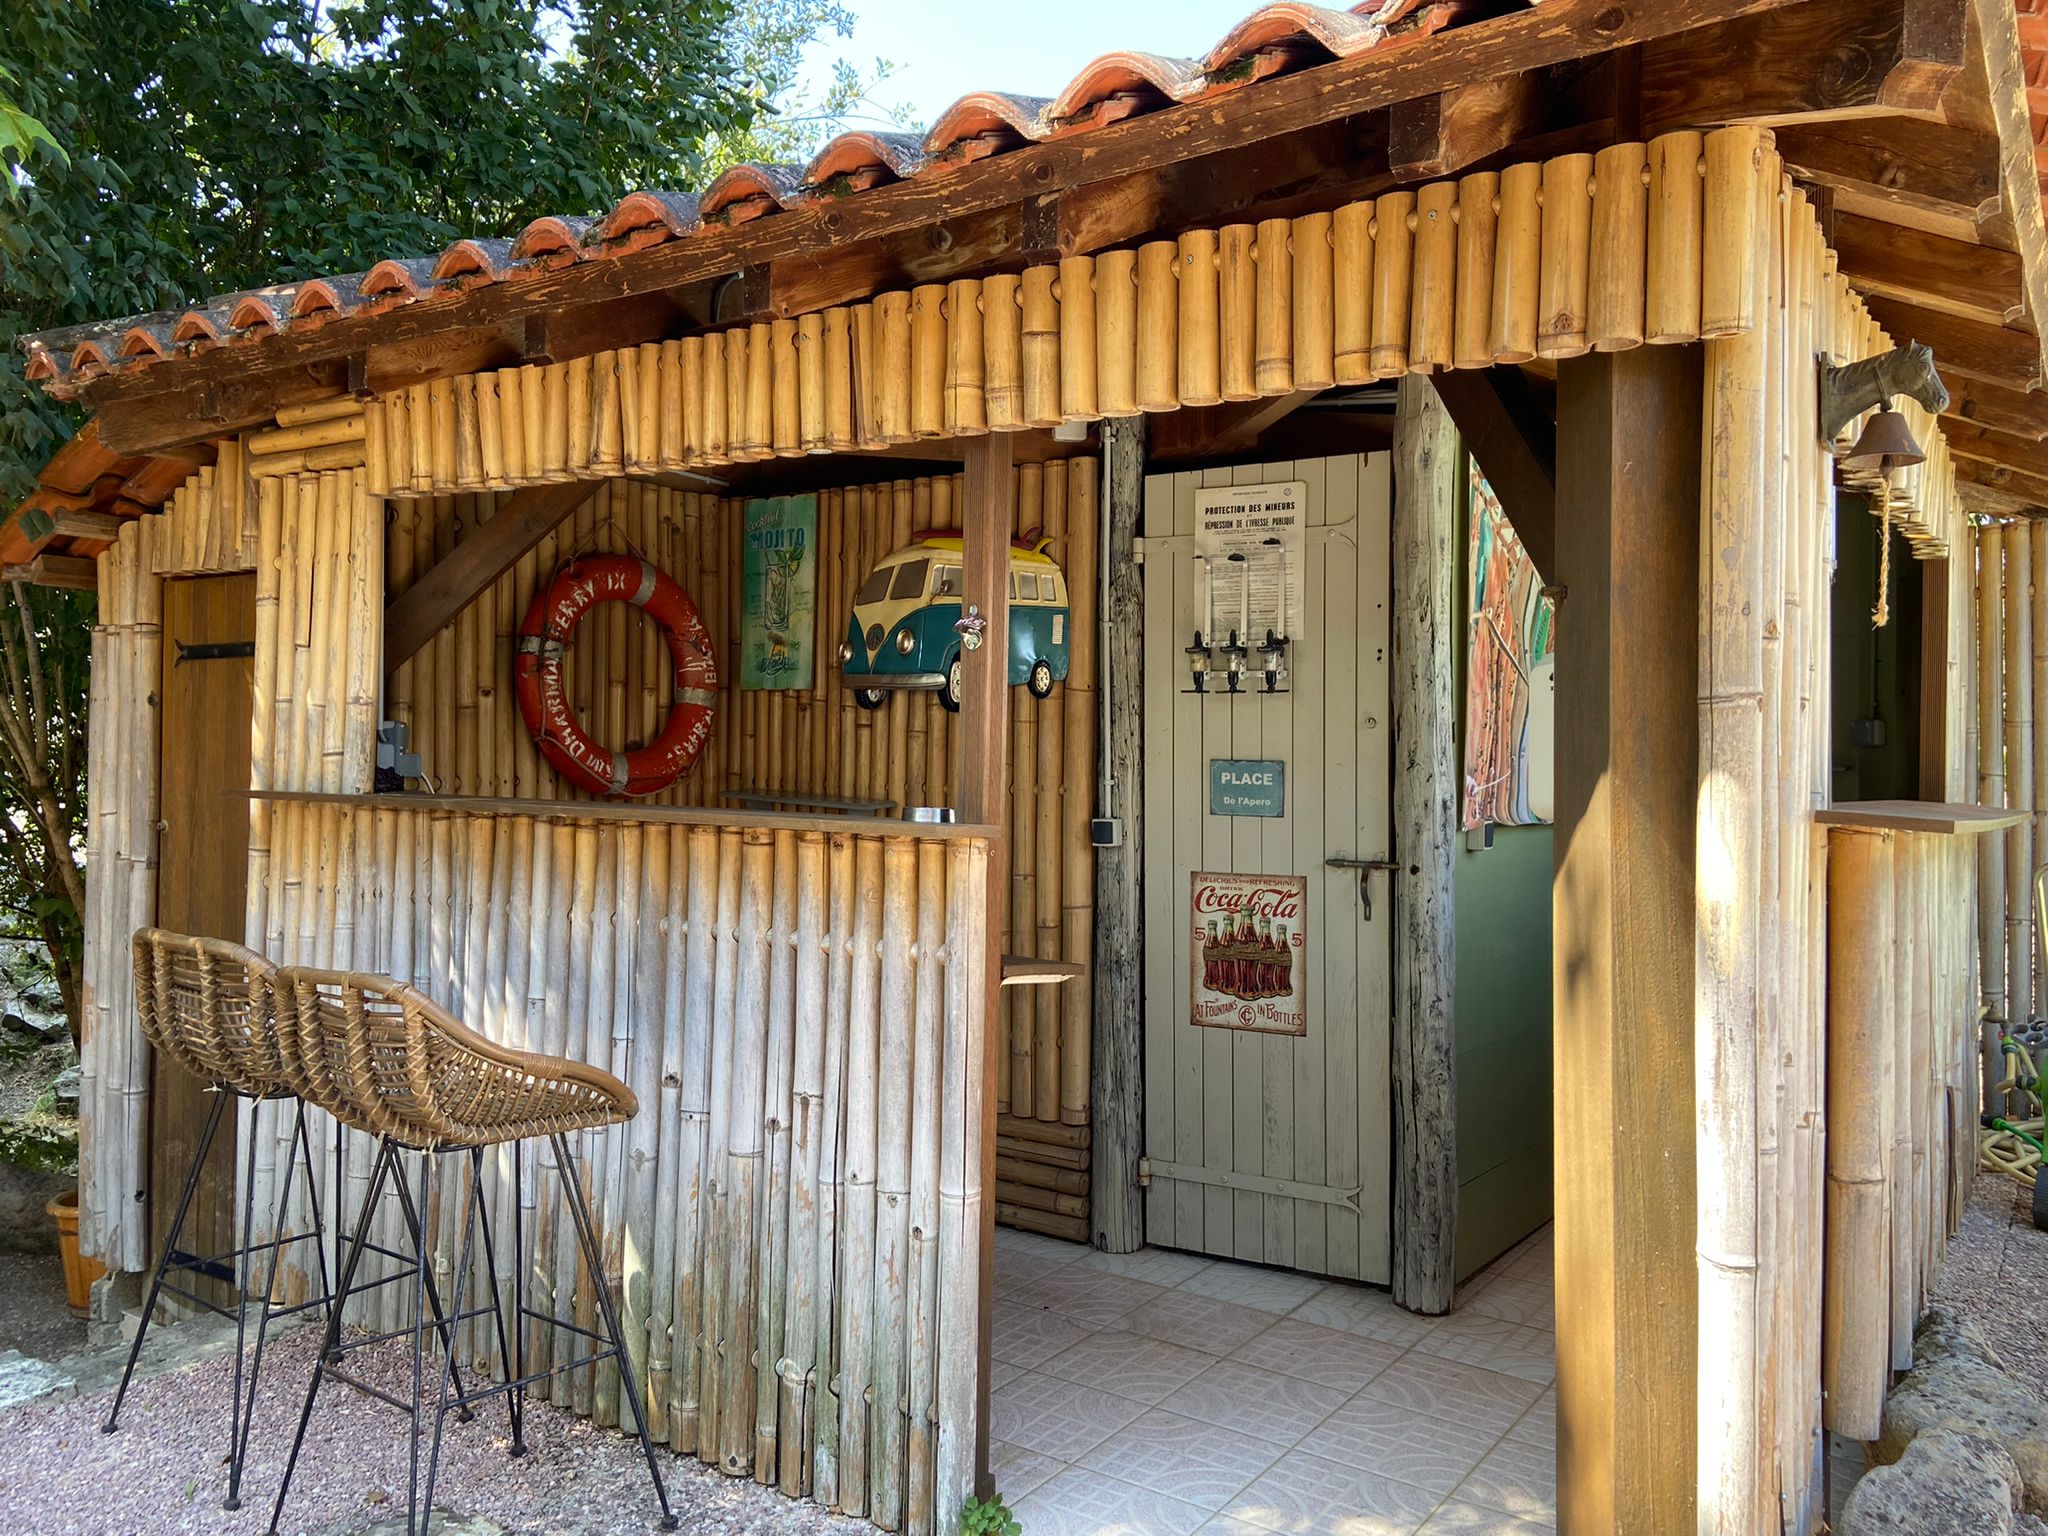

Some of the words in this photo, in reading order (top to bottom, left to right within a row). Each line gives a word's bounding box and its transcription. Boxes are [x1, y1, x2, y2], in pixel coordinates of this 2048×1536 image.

[1204, 505, 1245, 515] PROTECTION
[1249, 504, 1262, 512] DES
[1265, 501, 1296, 511] MINEURS
[1236, 519, 1243, 529] DE
[1272, 515, 1296, 526] PUBLIQUE
[751, 527, 805, 549] MOJITO
[550, 578, 596, 636] FERRY
[1220, 772, 1273, 786] PLACE
[1199, 876, 1239, 884] DELICIOUS
[1249, 878, 1295, 886] REFRESHING
